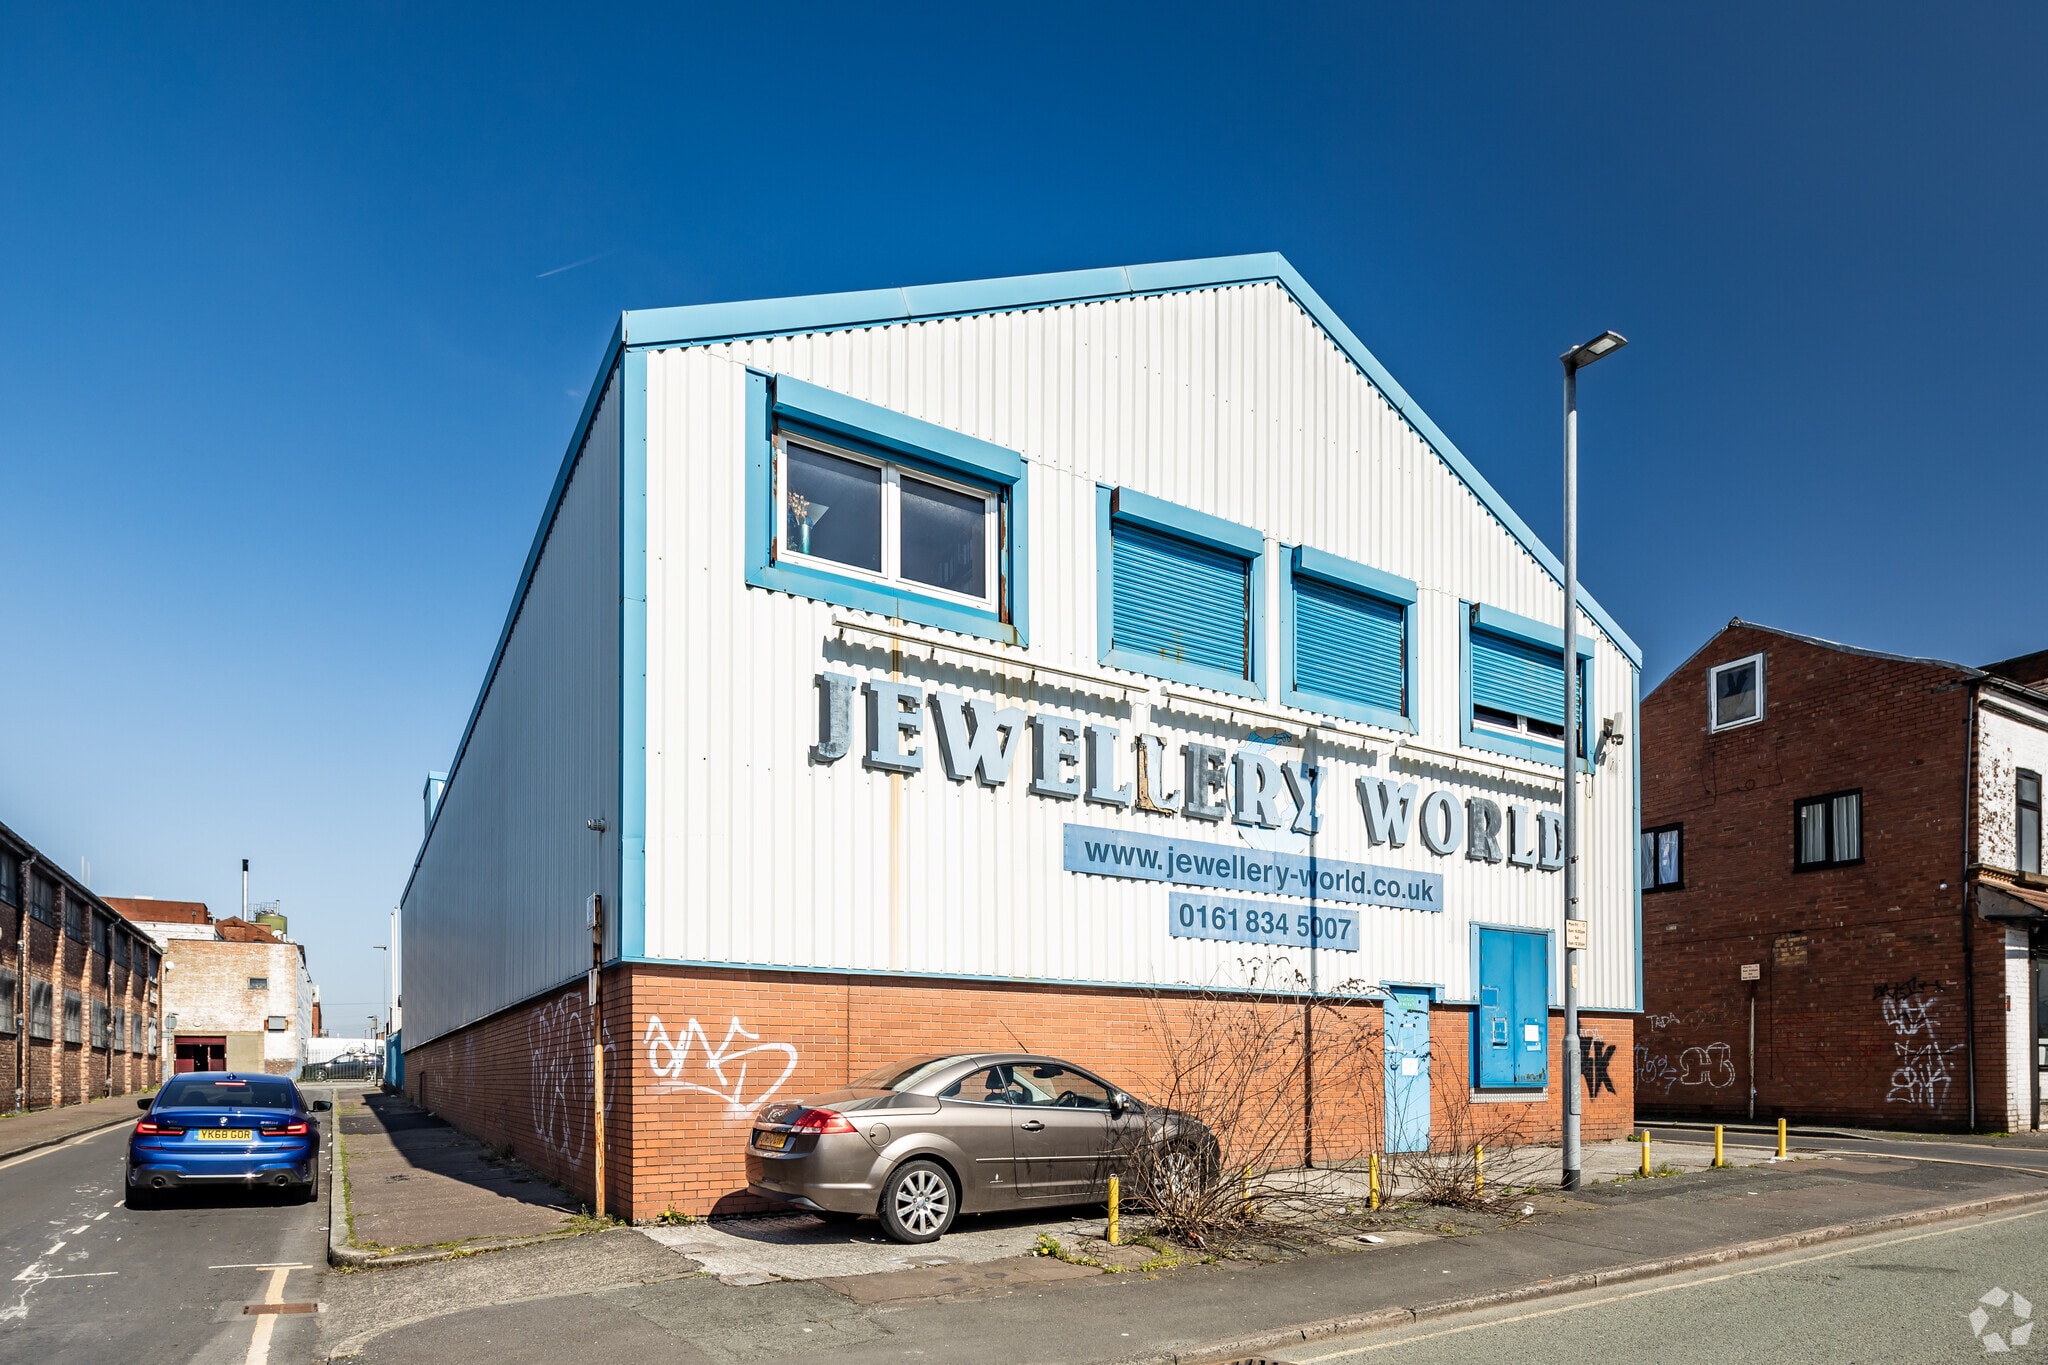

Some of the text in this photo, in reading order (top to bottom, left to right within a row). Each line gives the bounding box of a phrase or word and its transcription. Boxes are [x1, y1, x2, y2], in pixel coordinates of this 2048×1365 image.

[810, 671, 1565, 871] JEWELLERY WORLD
[1084, 840, 1434, 903] www.jewellery-world.co.uk
[1178, 903, 1353, 941] 0161 834 5007
[201, 1129, 250, 1140] YK68 GOR
